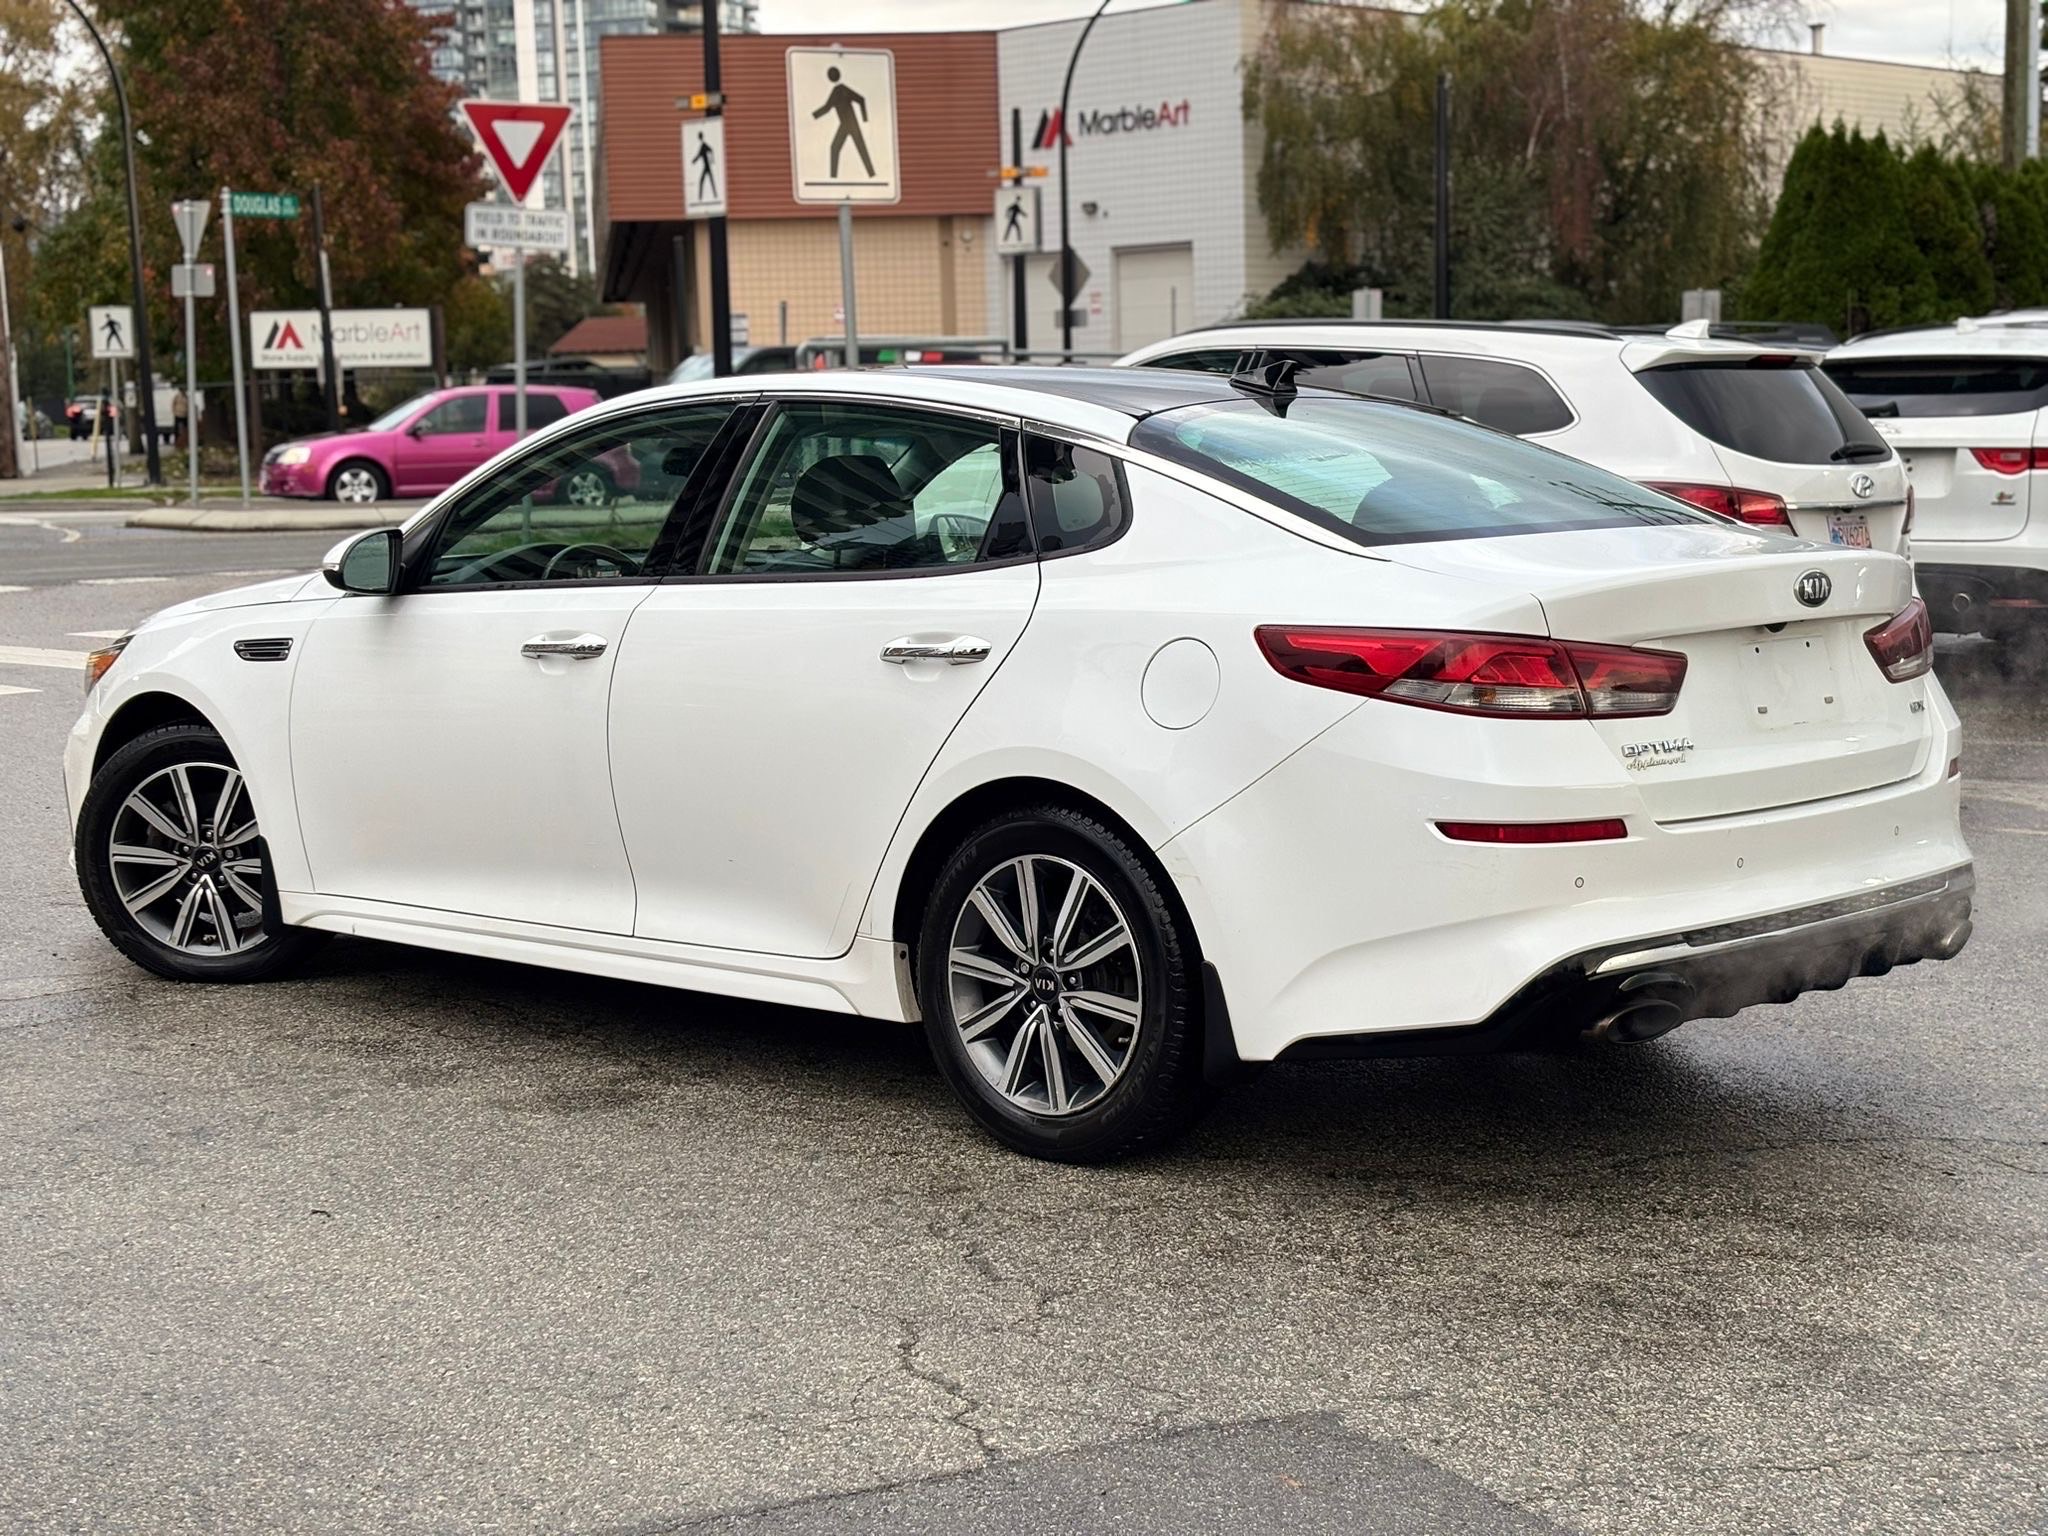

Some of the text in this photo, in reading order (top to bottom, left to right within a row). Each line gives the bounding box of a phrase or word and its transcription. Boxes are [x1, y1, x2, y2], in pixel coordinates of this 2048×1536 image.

[1078, 99, 1190, 136] MarbleArt
[233, 194, 280, 216] DOUGLAS
[1803, 577, 1828, 599] KIA
[1621, 737, 1694, 757] OPTIMA
[197, 852, 216, 867] KIA
[1035, 978, 1055, 991] KIA
